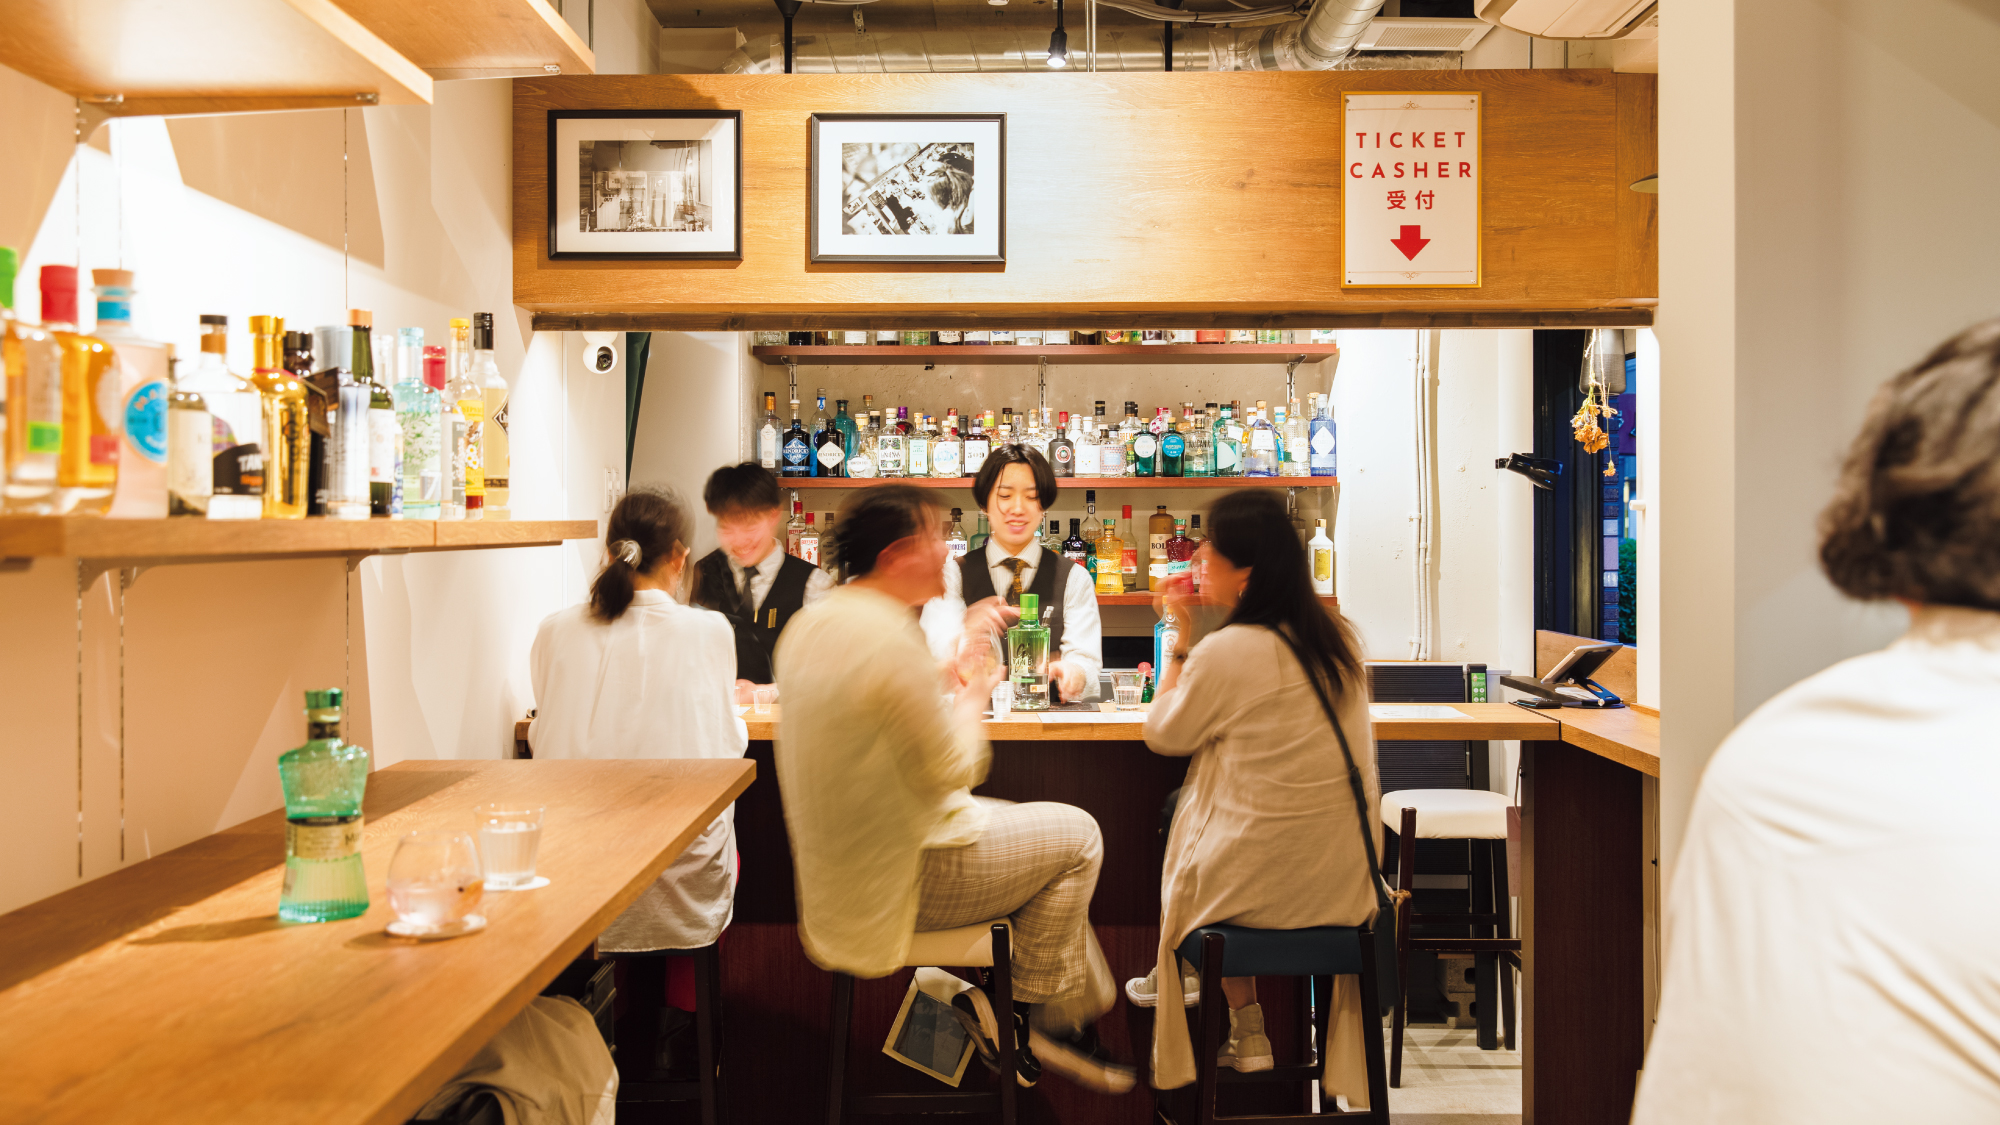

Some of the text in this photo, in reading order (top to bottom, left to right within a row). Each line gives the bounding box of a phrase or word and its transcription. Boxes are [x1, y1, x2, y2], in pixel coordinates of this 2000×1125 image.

[1355, 131, 1466, 149] TICKET
[1349, 161, 1472, 179] CASHER
[1386, 189, 1436, 211] 受付
